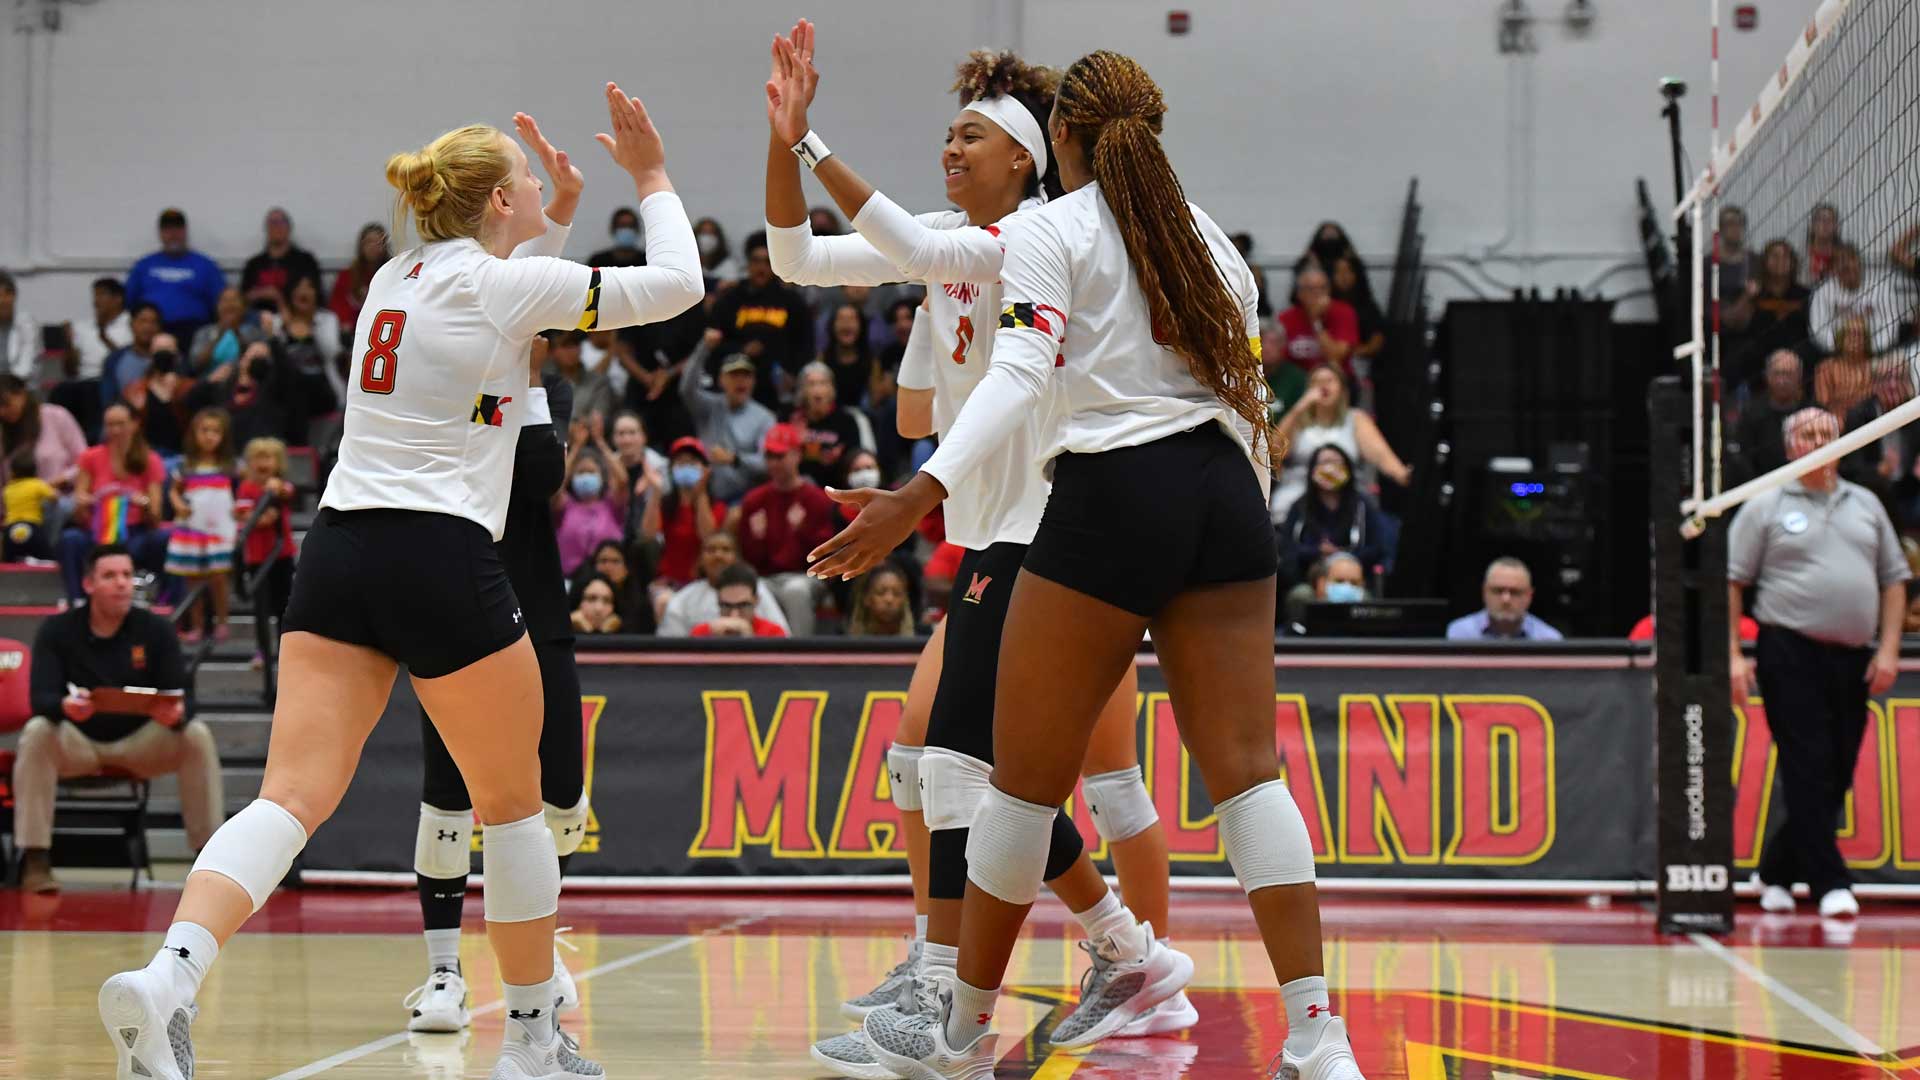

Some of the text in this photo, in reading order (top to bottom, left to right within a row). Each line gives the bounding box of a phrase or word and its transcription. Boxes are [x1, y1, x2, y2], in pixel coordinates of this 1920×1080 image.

[360, 309, 407, 395] 8
[963, 572, 993, 604] M
[1684, 703, 1706, 765] sports
[688, 690, 1558, 867] MALND
